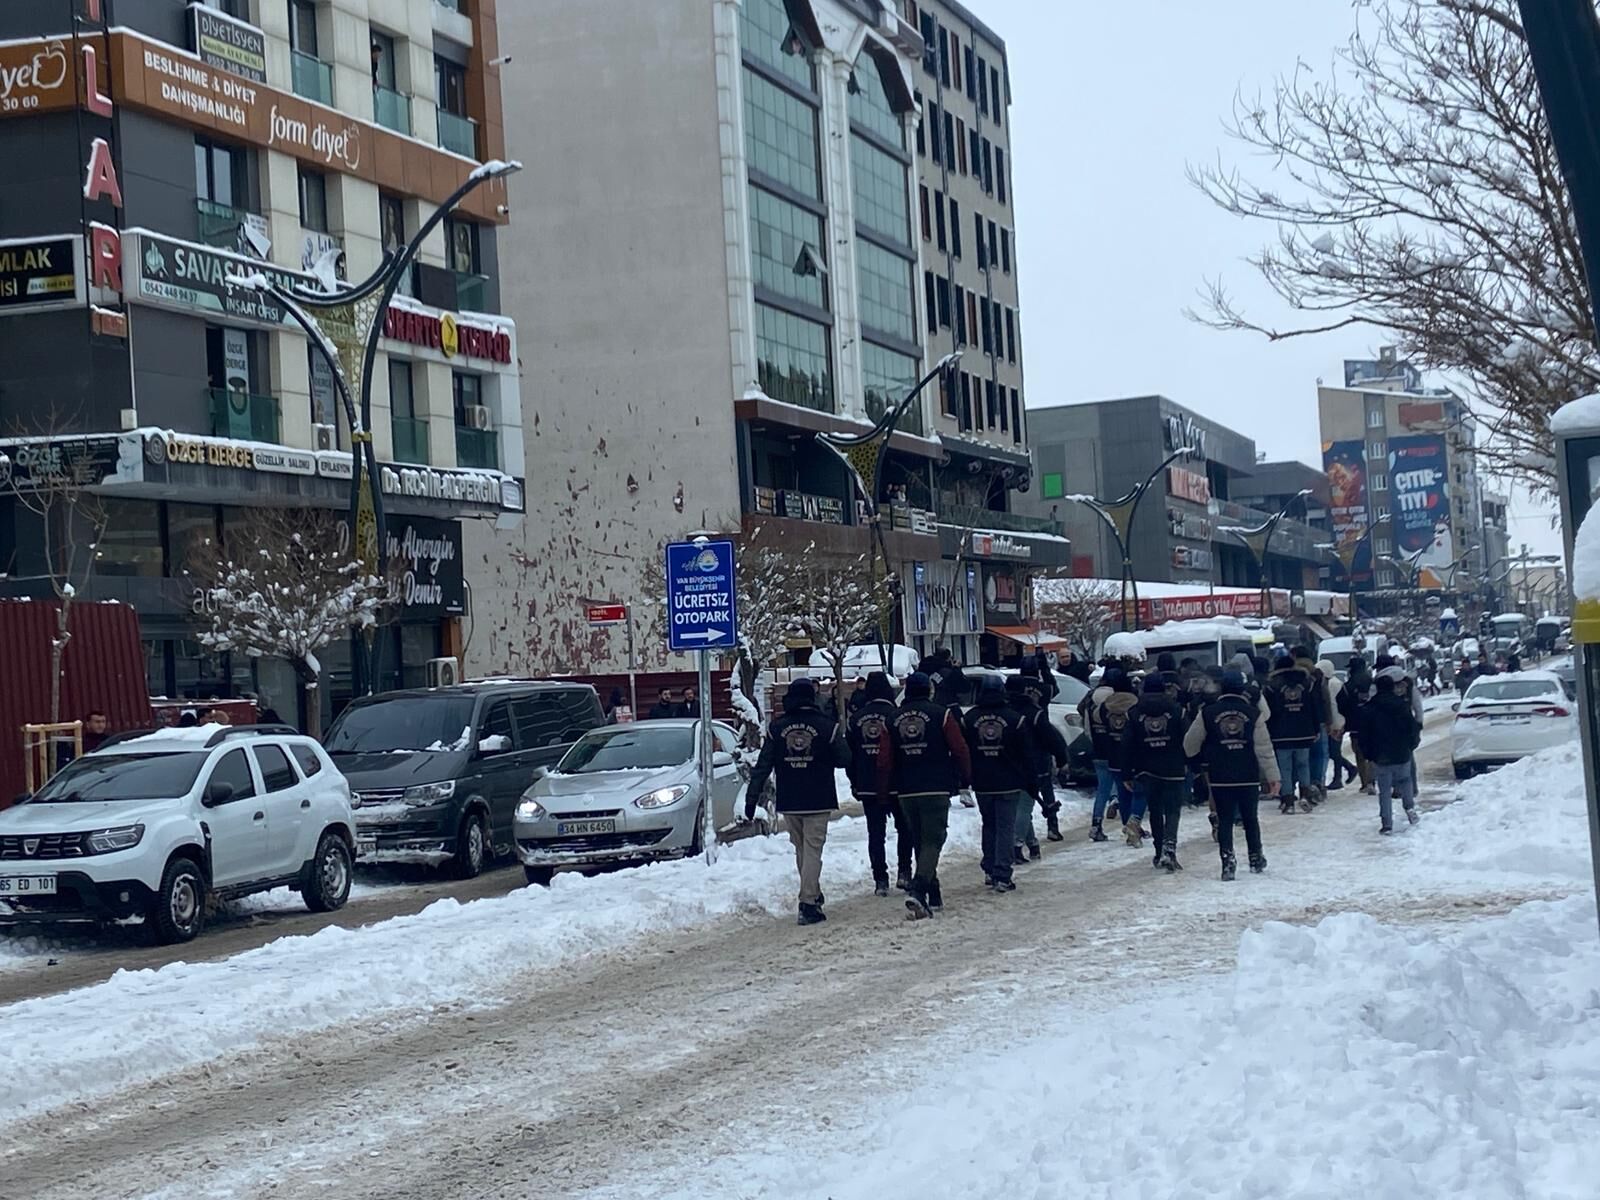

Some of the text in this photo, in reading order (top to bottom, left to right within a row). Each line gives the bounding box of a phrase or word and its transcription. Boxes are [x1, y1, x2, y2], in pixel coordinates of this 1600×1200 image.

[143, 48, 209, 89] BESLENME
[223, 79, 257, 106] DİYET
[3, 95, 39, 111] 30 60
[161, 82, 246, 126] DANIŞMANLIĞI
[268, 104, 350, 163] form diyet
[144, 281, 163, 297] 0542
[226, 296, 257, 316] İNŞAAT
[383, 305, 441, 349] URARTU
[226, 342, 244, 355] ÖZGE
[167, 434, 253, 468] ÖZGE DERGE
[255, 453, 286, 467] GÜZELLİK
[402, 525, 455, 575] Alpergin
[403, 570, 443, 606] Demir
[674, 592, 729, 609] ÜCRETSİZ
[1164, 598, 1202, 617] YAĞMUR
[674, 610, 730, 625] OTOPARK
[17, 878, 30, 891] ED
[38, 877, 54, 890] 101
